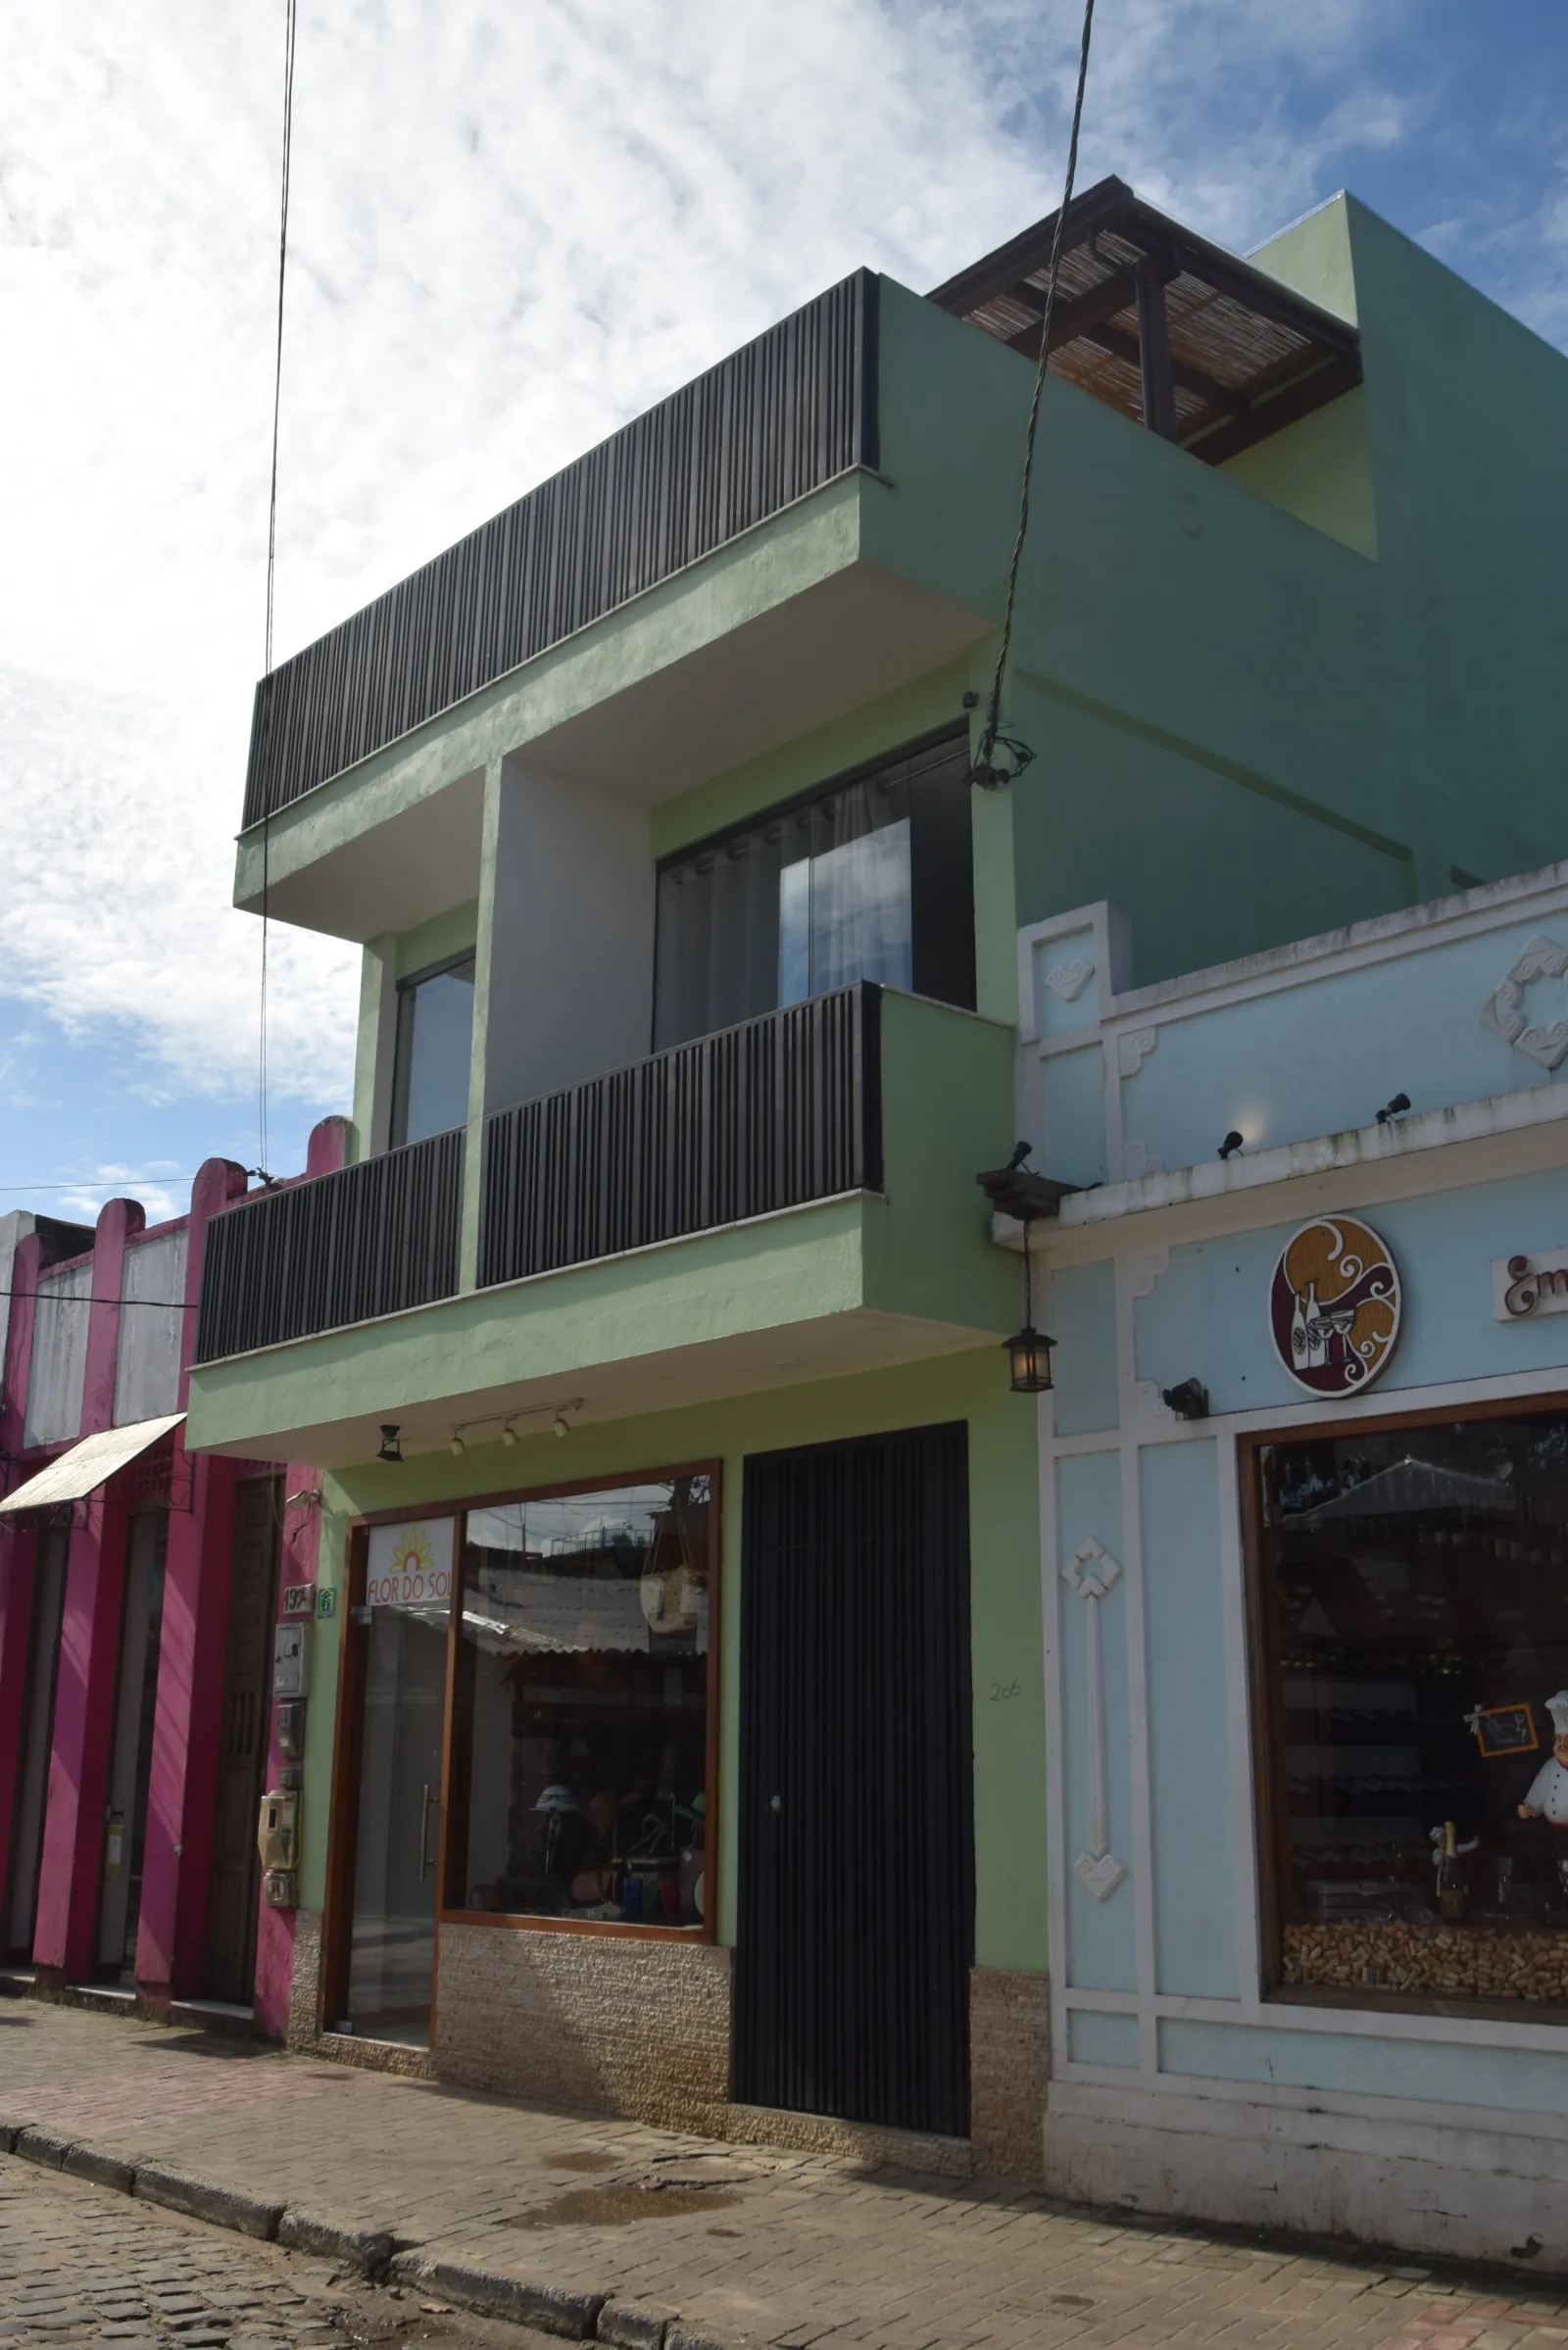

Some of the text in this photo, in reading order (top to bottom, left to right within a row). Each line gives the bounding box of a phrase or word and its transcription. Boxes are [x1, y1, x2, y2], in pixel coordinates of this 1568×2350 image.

[368, 1571, 451, 1604] FLOR DO SOL
